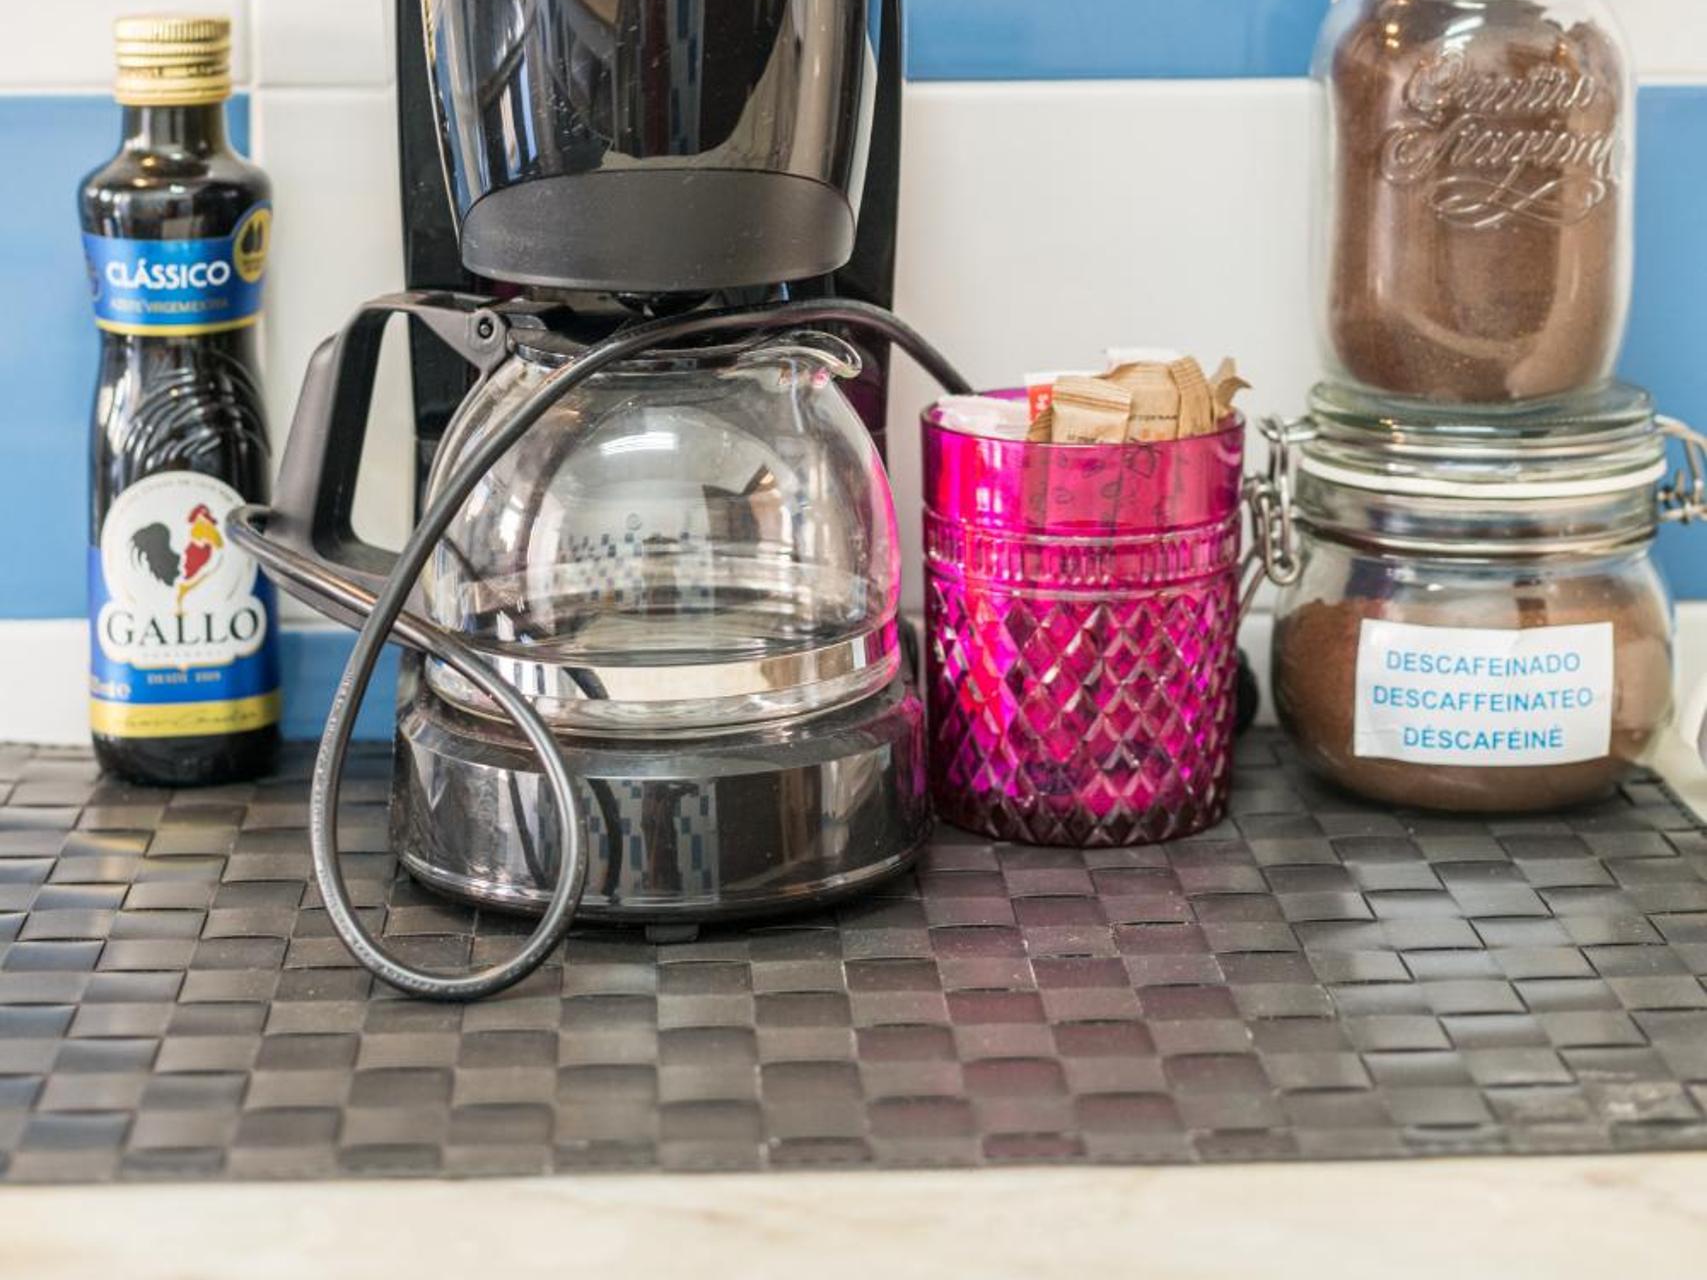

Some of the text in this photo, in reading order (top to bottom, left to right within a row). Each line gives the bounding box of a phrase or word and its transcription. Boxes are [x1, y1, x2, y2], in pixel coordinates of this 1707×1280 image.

[105, 257, 231, 290] CLÁSSICO
[106, 606, 260, 647] GALLO
[1386, 650, 1581, 677] DESCAFEINADO
